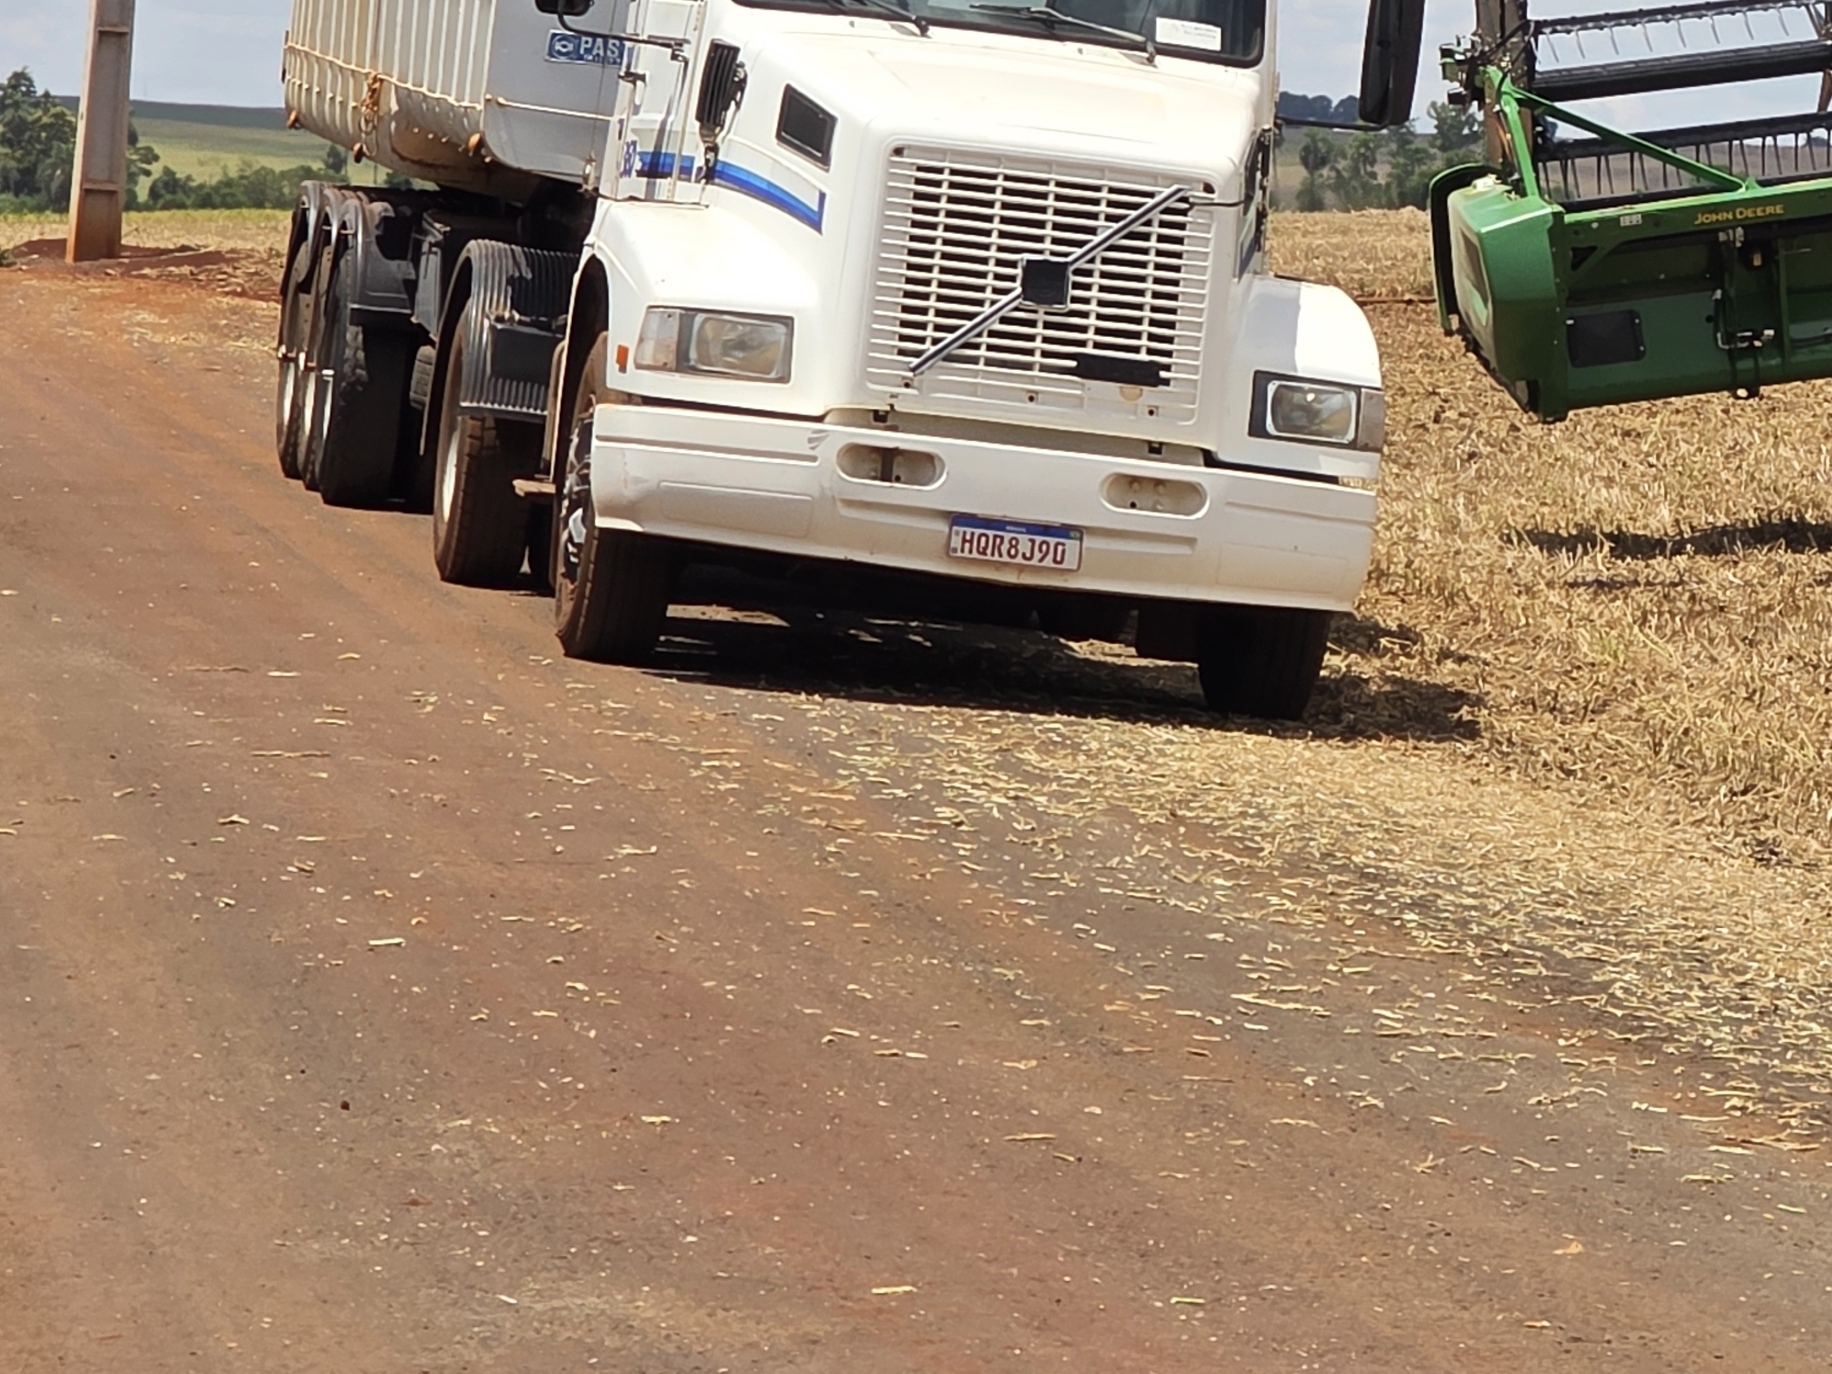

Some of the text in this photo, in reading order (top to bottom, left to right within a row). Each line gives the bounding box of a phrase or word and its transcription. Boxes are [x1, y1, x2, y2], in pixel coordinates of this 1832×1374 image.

[579, 36, 621, 58] PAS
[1694, 204, 1785, 225] JOHN DEERE
[960, 530, 1067, 566] HQR8J90
